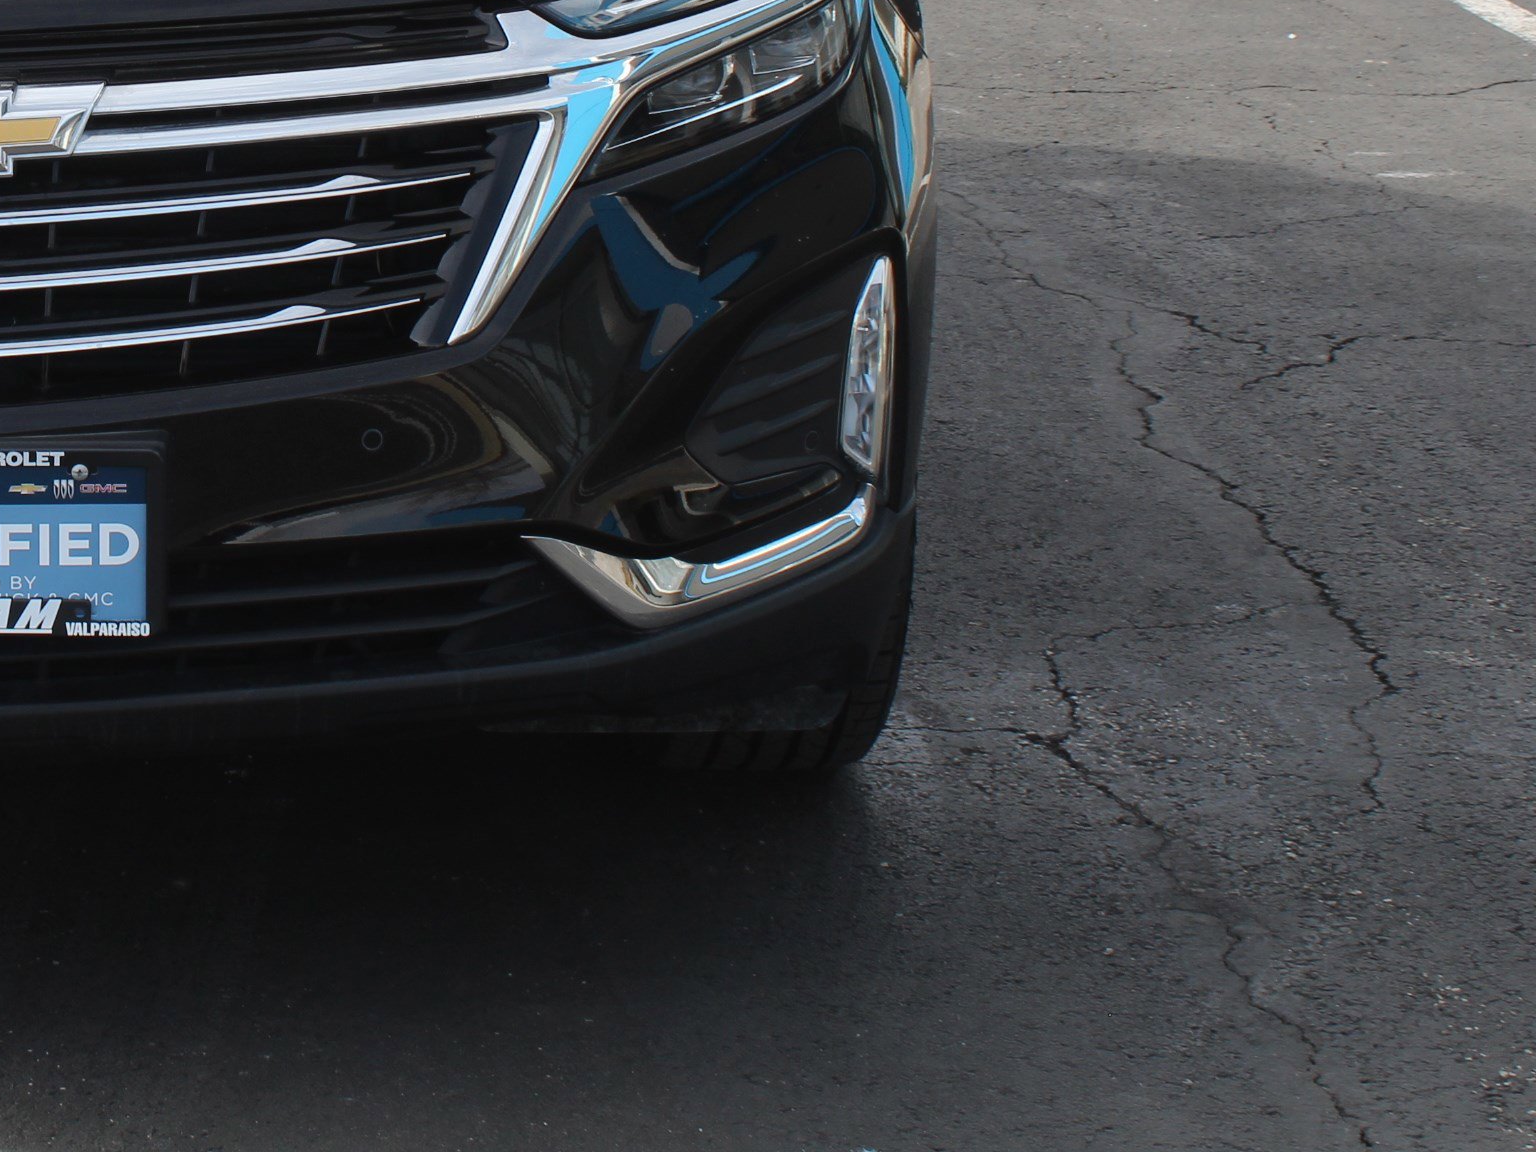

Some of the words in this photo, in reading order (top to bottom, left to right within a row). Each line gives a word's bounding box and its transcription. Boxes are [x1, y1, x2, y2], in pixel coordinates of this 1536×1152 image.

[79, 483, 128, 494] GMC
[11, 575, 37, 590] BY
[65, 622, 150, 637] VALPARAISO
